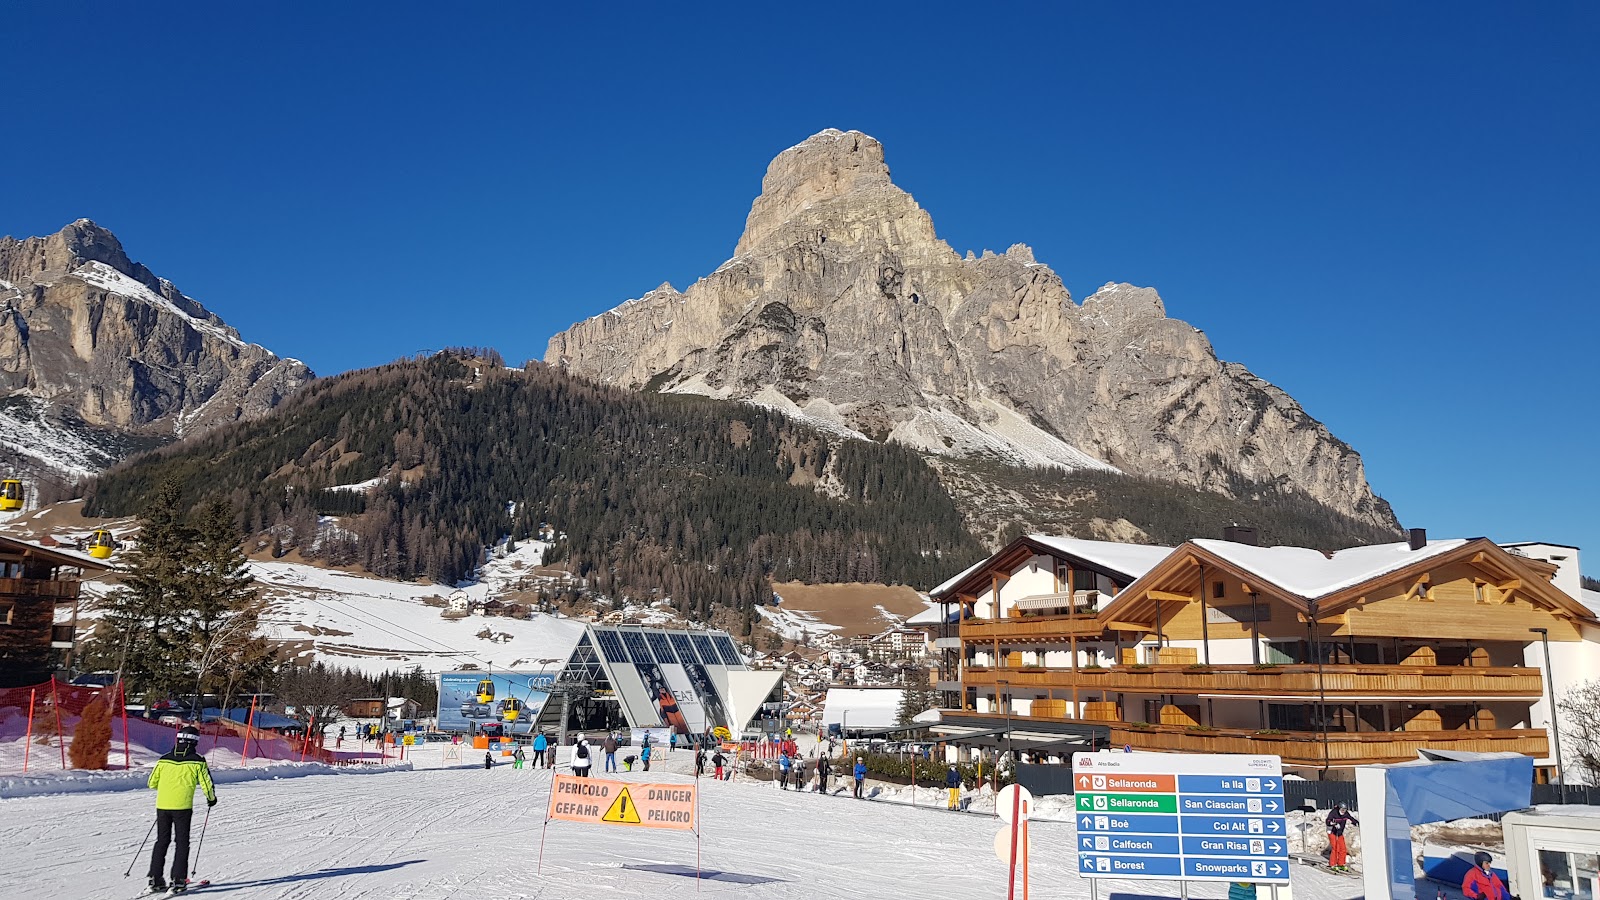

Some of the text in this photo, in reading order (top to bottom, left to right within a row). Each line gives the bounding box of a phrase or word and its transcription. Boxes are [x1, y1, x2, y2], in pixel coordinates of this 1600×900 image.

[558, 782, 608, 797] PERICOLO
[1108, 779, 1157, 789] Sellaronda
[648, 789, 692, 803] DANGER
[555, 802, 599, 817] GEFAHR
[1110, 799, 1159, 809] Sellaronda
[1185, 799, 1245, 810] San Ciascian
[647, 809, 690, 823] PELIGRO
[1111, 820, 1129, 829] Boè
[1213, 821, 1246, 831] Col Alt
[1112, 840, 1153, 850] Calfosch
[1201, 840, 1224, 850] Gran
[1228, 841, 1248, 851] Risa
[1114, 860, 1145, 870] Borest
[1195, 862, 1248, 875] Snowparks
